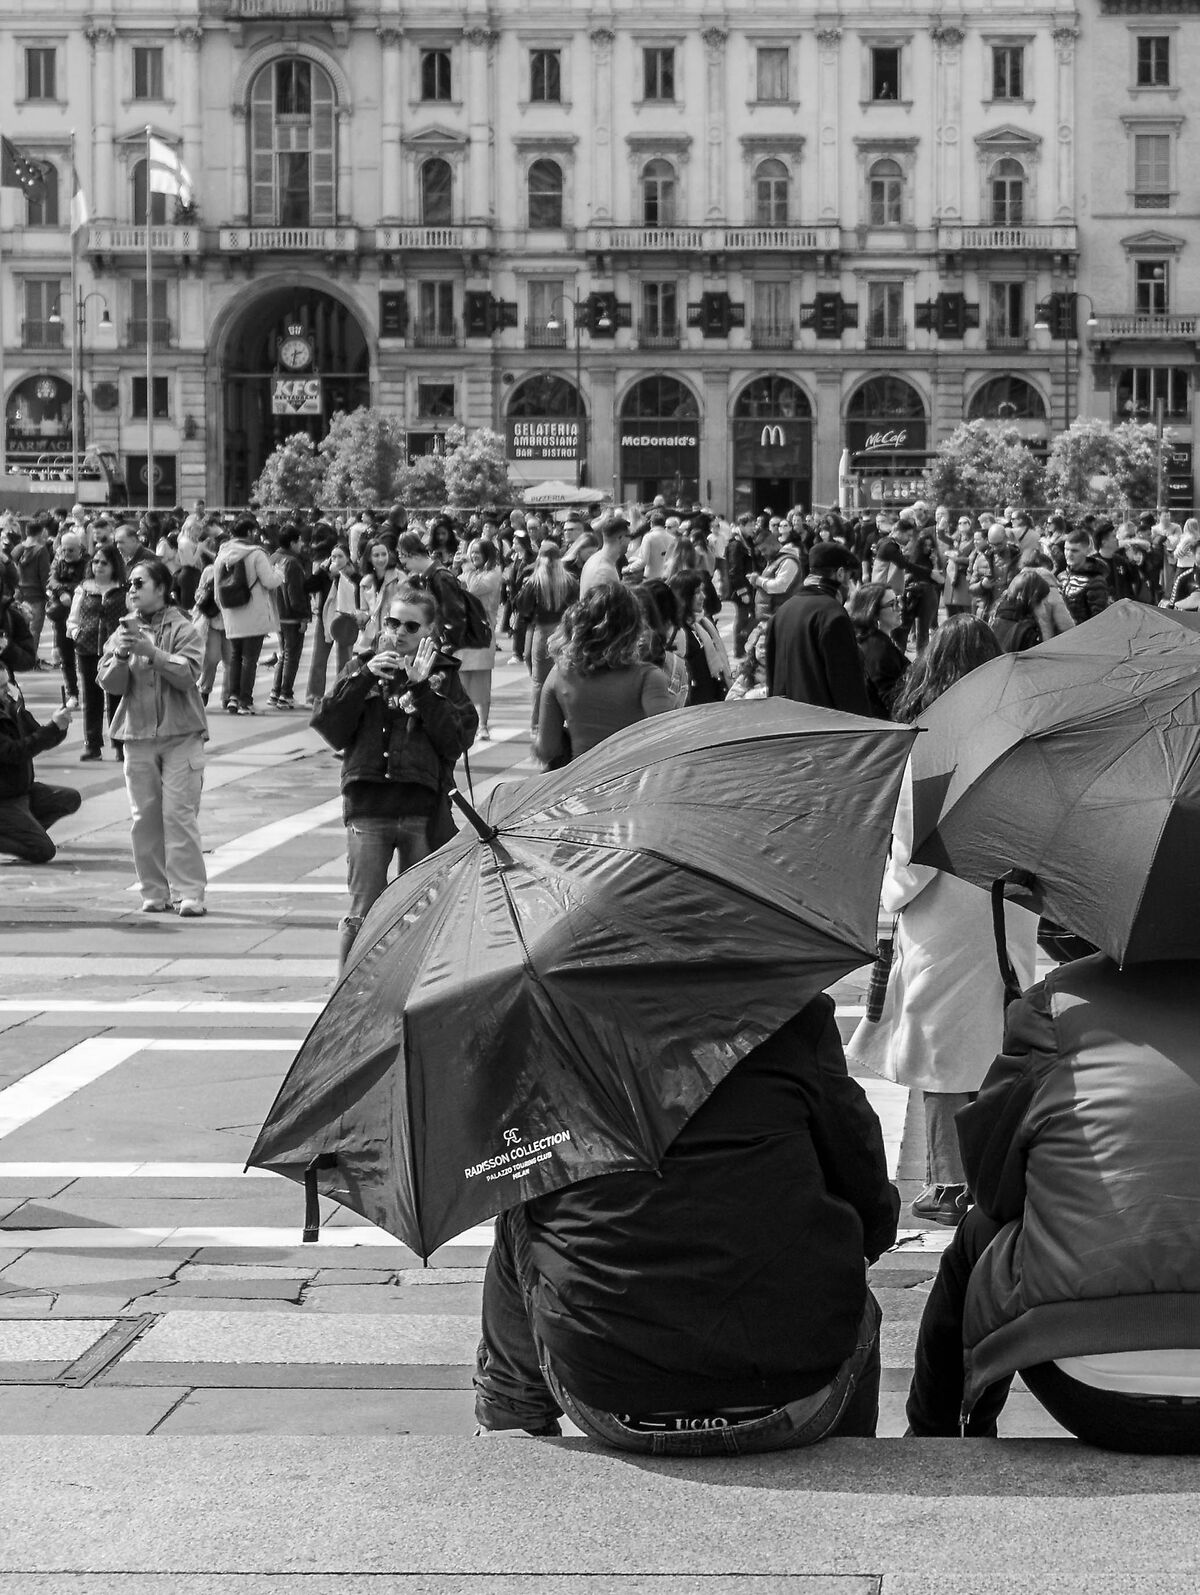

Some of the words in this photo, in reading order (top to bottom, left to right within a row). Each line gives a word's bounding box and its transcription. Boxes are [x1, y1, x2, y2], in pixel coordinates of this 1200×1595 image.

[274, 380, 319, 396] KFC
[514, 423, 579, 436] GELATERIA
[9, 440, 71, 451] FARMACI
[513, 436, 578, 446] AMBROSIANA
[621, 436, 696, 447] McDonald's
[515, 448, 532, 458] BAR
[542, 448, 576, 458] BISTROT
[464, 1152, 511, 1179] RADISSON
[510, 1130, 571, 1160] COLLECTION
[486, 1166, 513, 1181] PALAZZO
[512, 1157, 537, 1171] TOURING
[537, 1151, 553, 1162] CLUB
[512, 1168, 530, 1180] MILAN
